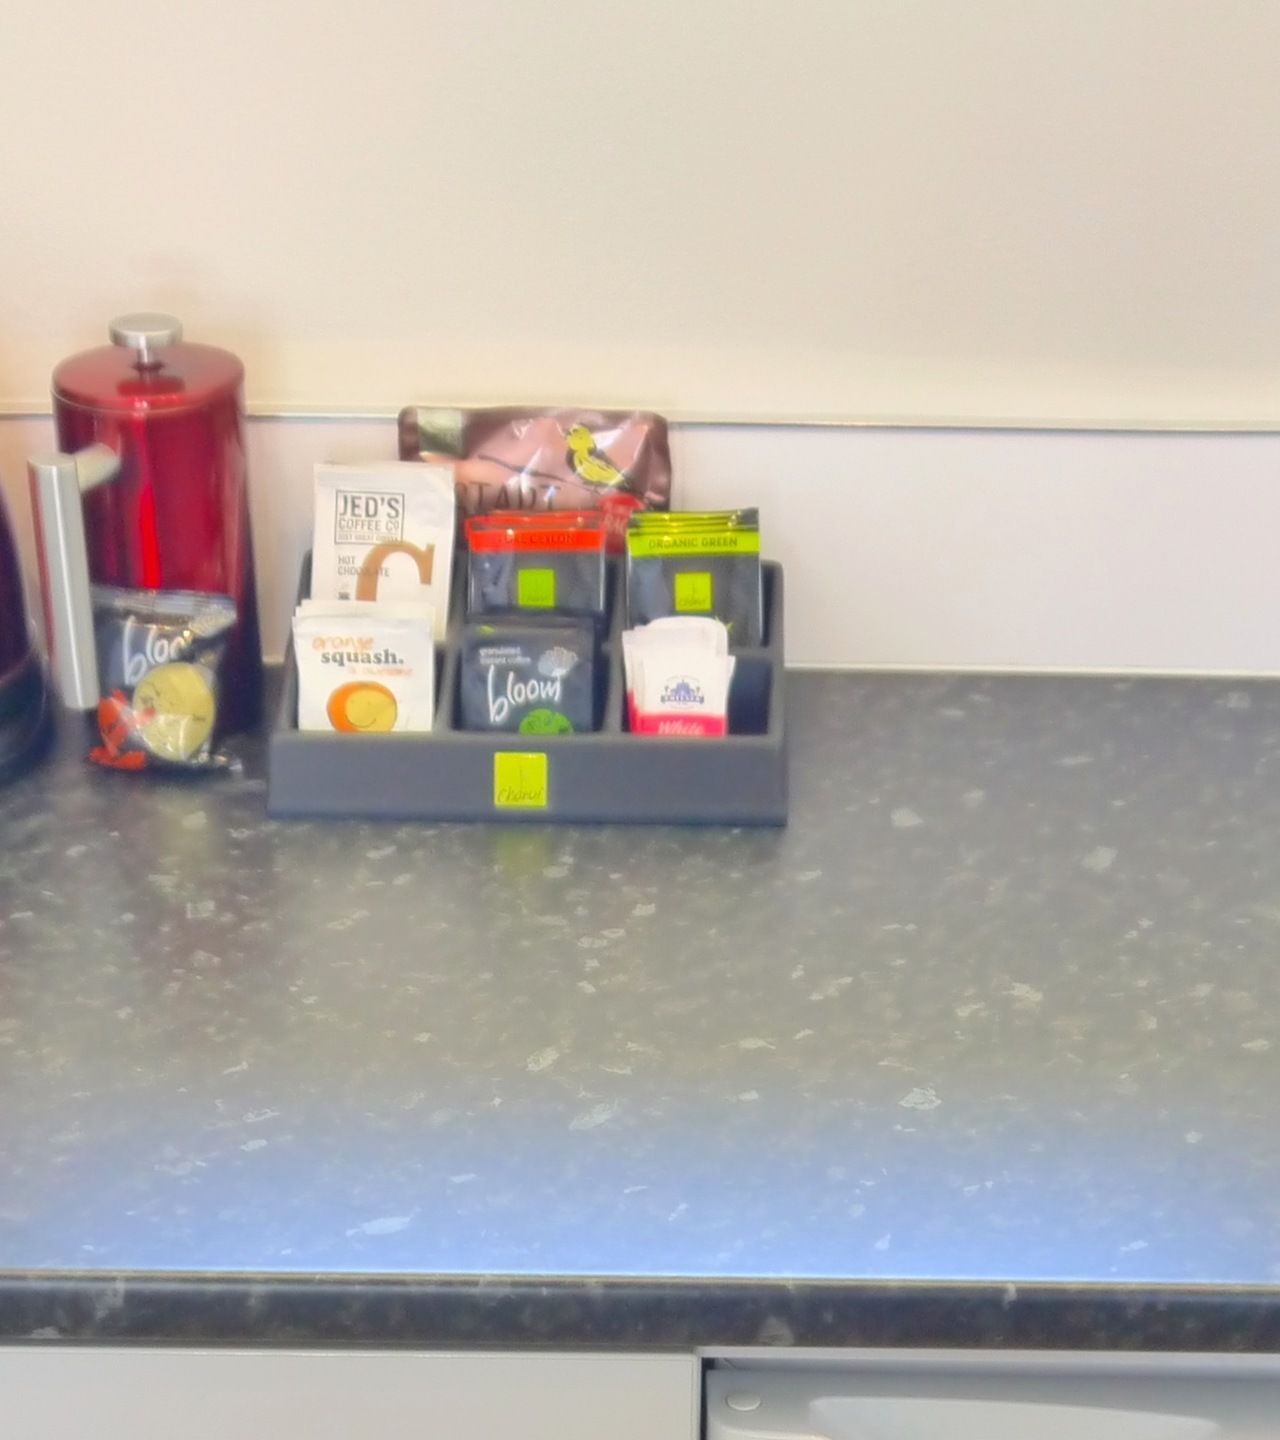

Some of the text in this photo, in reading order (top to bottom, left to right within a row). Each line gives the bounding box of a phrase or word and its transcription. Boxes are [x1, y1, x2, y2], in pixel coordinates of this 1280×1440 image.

[339, 494, 401, 520] JED'S
[338, 518, 382, 532] COFFEE
[648, 537, 738, 550] ORGANIC GREEN
[337, 555, 356, 566] HOT
[320, 648, 405, 667] squash.
[487, 663, 562, 723] bloom
